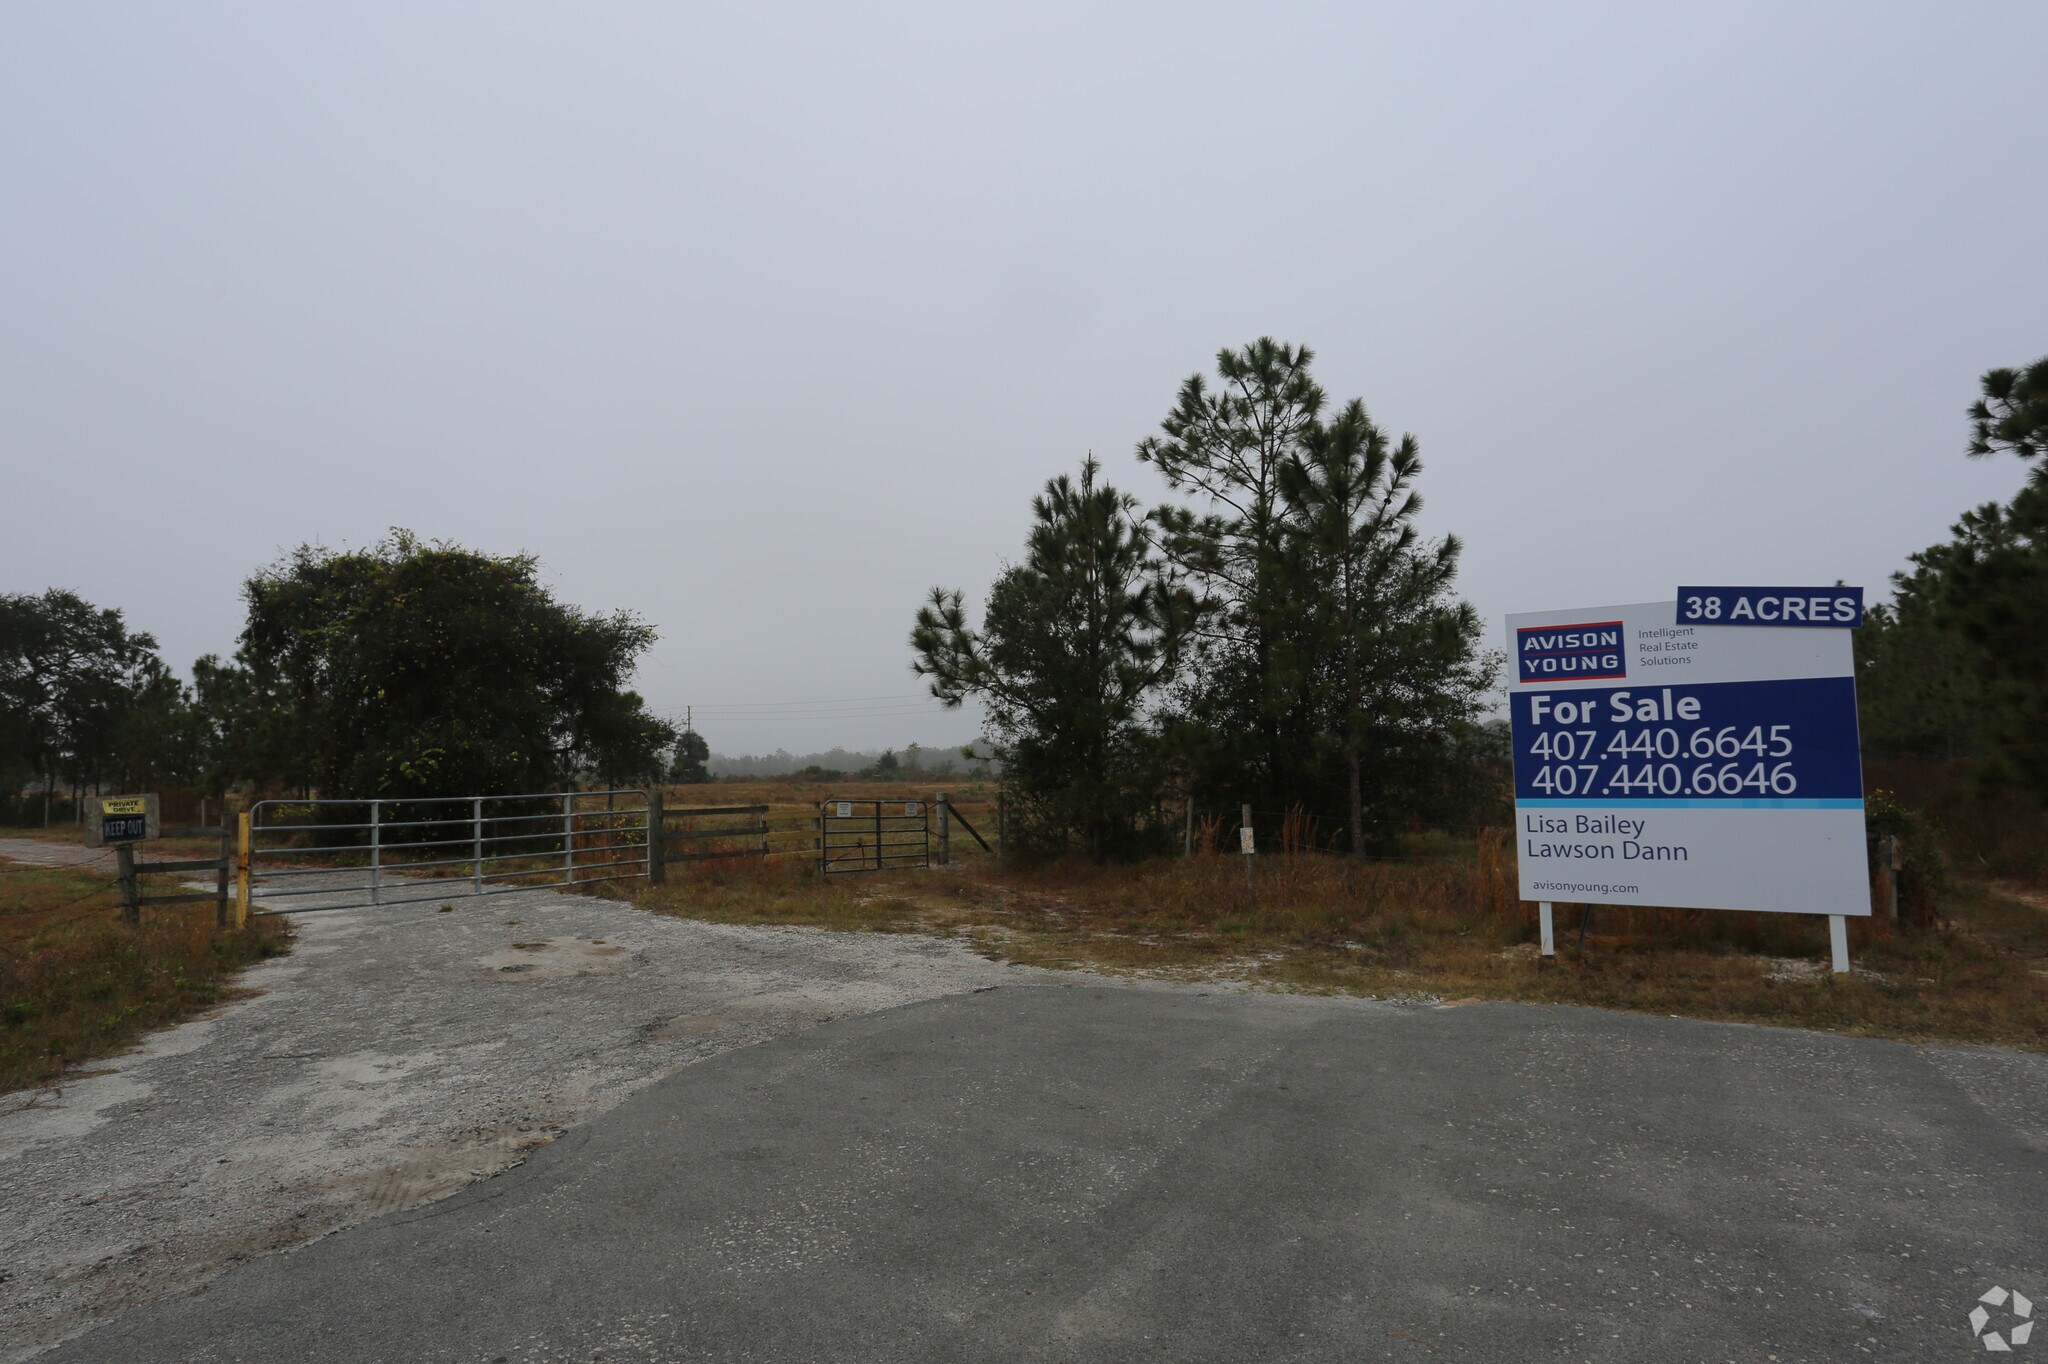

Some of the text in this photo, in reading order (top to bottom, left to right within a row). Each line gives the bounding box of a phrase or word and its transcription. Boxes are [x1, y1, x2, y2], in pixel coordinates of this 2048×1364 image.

[1686, 596, 1856, 622] 38 ACRES
[1524, 631, 1618, 651] AVISON
[1638, 627, 1695, 640] Intelligent
[1639, 640, 1699, 653] Real Estate
[1525, 654, 1619, 673] YOUNG
[1640, 654, 1692, 667] Solutions
[1530, 688, 1702, 725] For Sale
[1530, 725, 1793, 761] 407.440.6645
[1531, 762, 1797, 796] 407.440.6646
[105, 819, 143, 837] KEEP OUT
[1526, 815, 1646, 840] Lisa Bailey
[1527, 839, 1689, 861] Lawson Dann
[1532, 879, 1640, 895] avisonyoung.com
